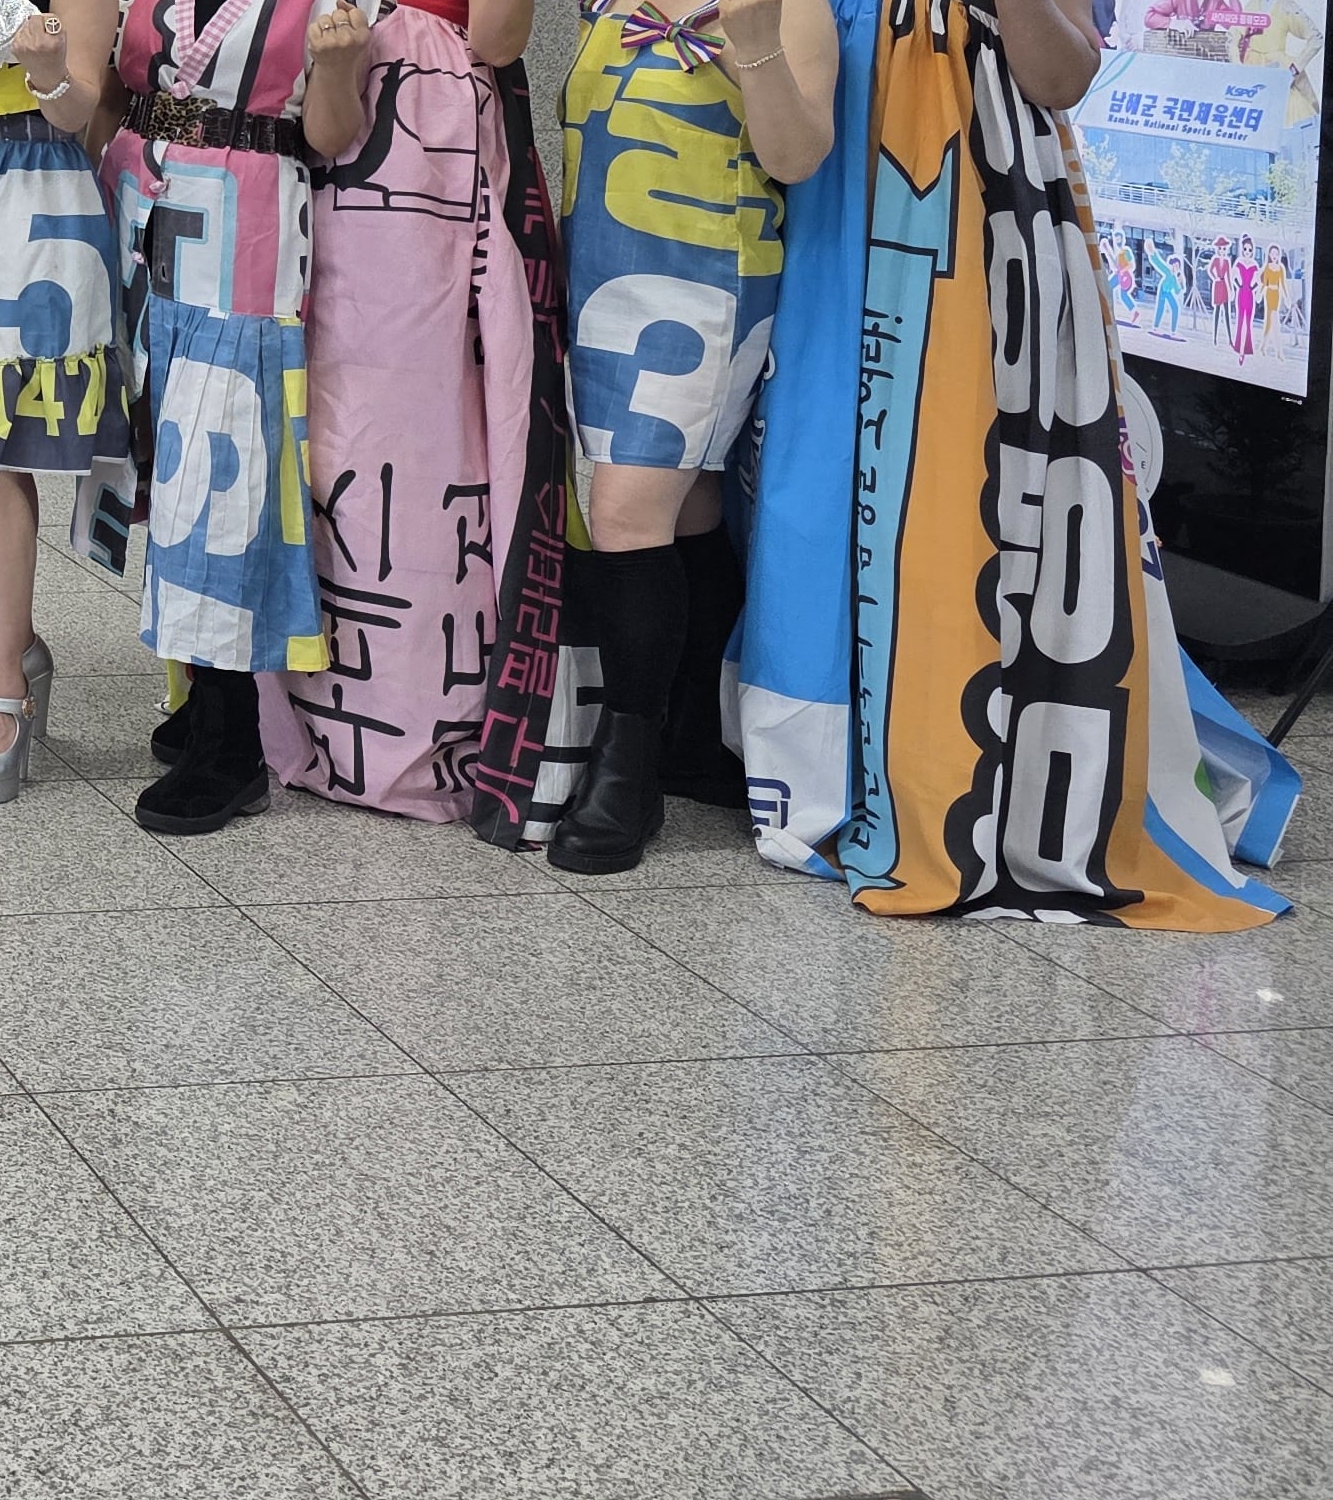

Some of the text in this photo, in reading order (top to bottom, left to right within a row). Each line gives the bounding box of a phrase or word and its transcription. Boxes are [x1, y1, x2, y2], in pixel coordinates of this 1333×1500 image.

[1225, 85, 1257, 99] KSPO
[1109, 90, 1264, 132] 남해군 국민체육센터
[1143, 118, 1180, 132] National
[1182, 123, 1212, 137] Sports
